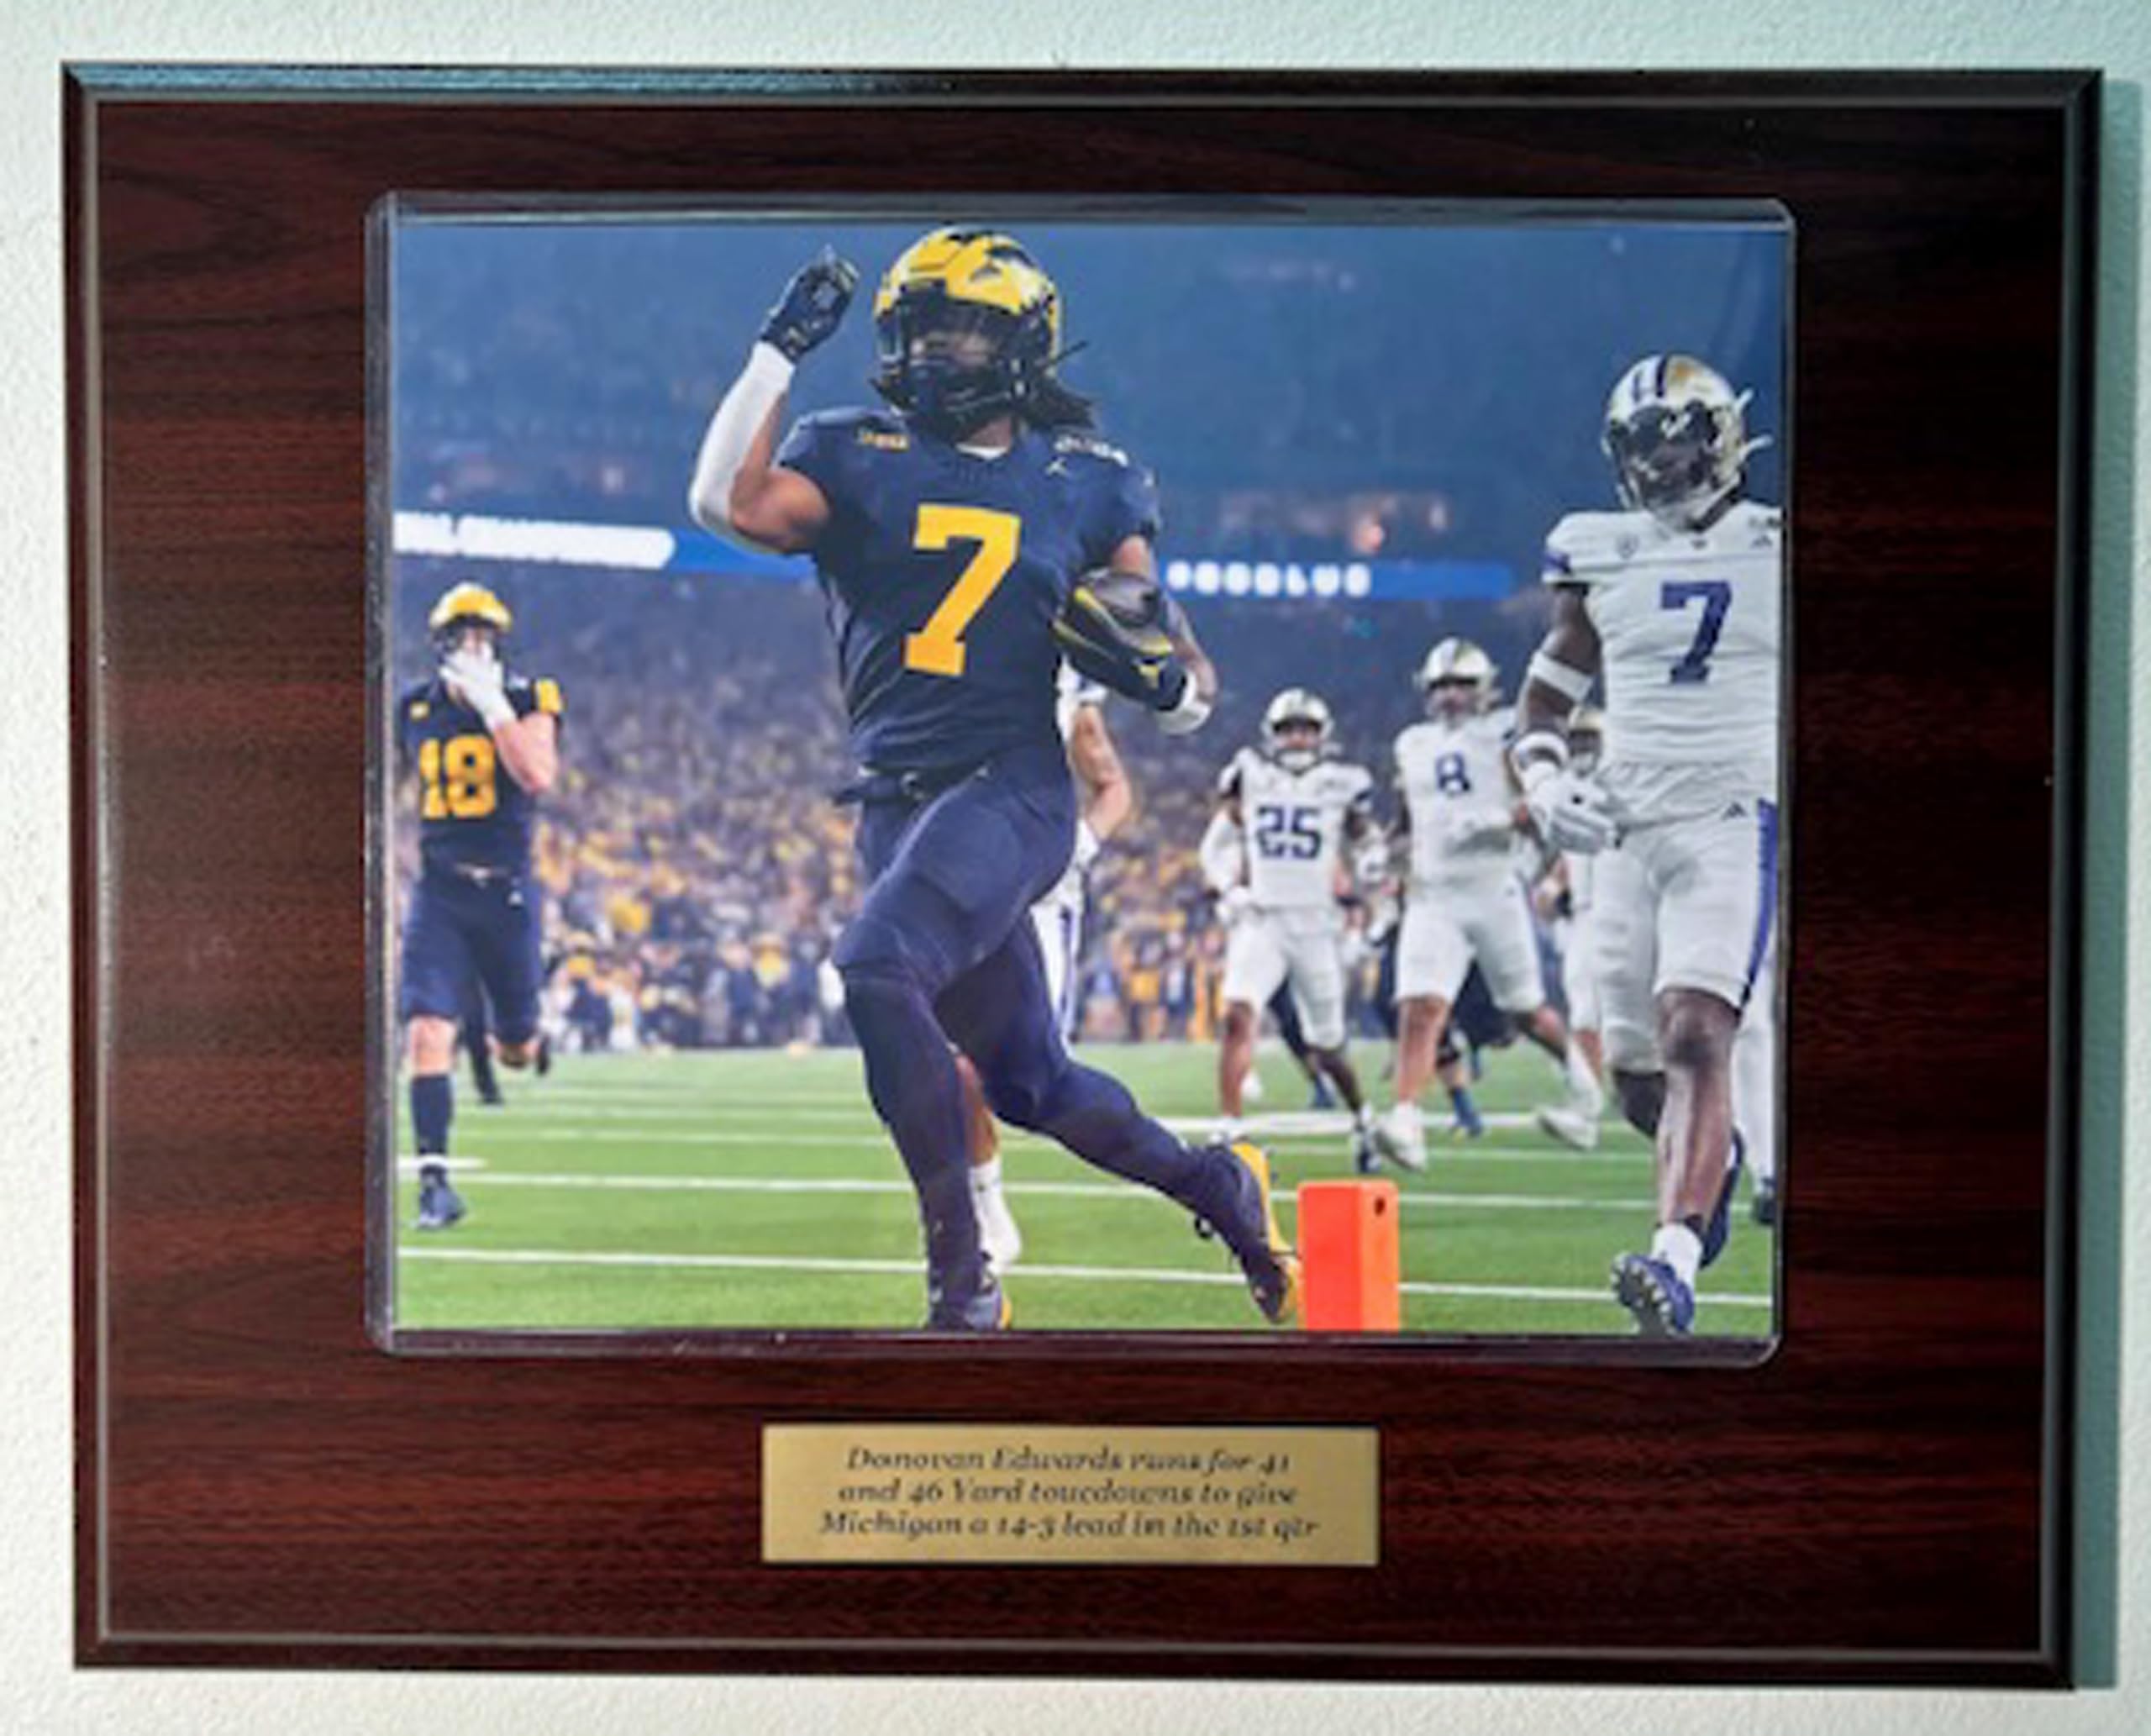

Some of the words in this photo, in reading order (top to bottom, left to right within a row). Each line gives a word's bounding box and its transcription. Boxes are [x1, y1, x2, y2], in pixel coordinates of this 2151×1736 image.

[905, 503, 1022, 676] 7
[1660, 580, 1733, 685] 7
[418, 734, 496, 822] 18
[1436, 754, 1470, 795] 8
[1256, 805, 1322, 860] 25
[847, 1445, 985, 1470] Donovan
[991, 1445, 1123, 1471] Edwards
[1130, 1454, 1202, 1470] runs
[1203, 1448, 1253, 1476] for
[1260, 1454, 1291, 1476] 41
[839, 1478, 902, 1502] and
[909, 1481, 944, 1507] 46
[953, 1478, 1024, 1503] Yard
[1199, 1484, 1232, 1504] to
[1235, 1481, 1296, 1510] give
[818, 1512, 962, 1542] Michigan
[970, 1519, 988, 1534] a
[1061, 1512, 1127, 1537] lead
[1133, 1512, 1165, 1537] in
[1173, 1512, 1220, 1538] the
[1228, 1518, 1266, 1539] 1st
[1272, 1516, 1321, 1544] qtr
